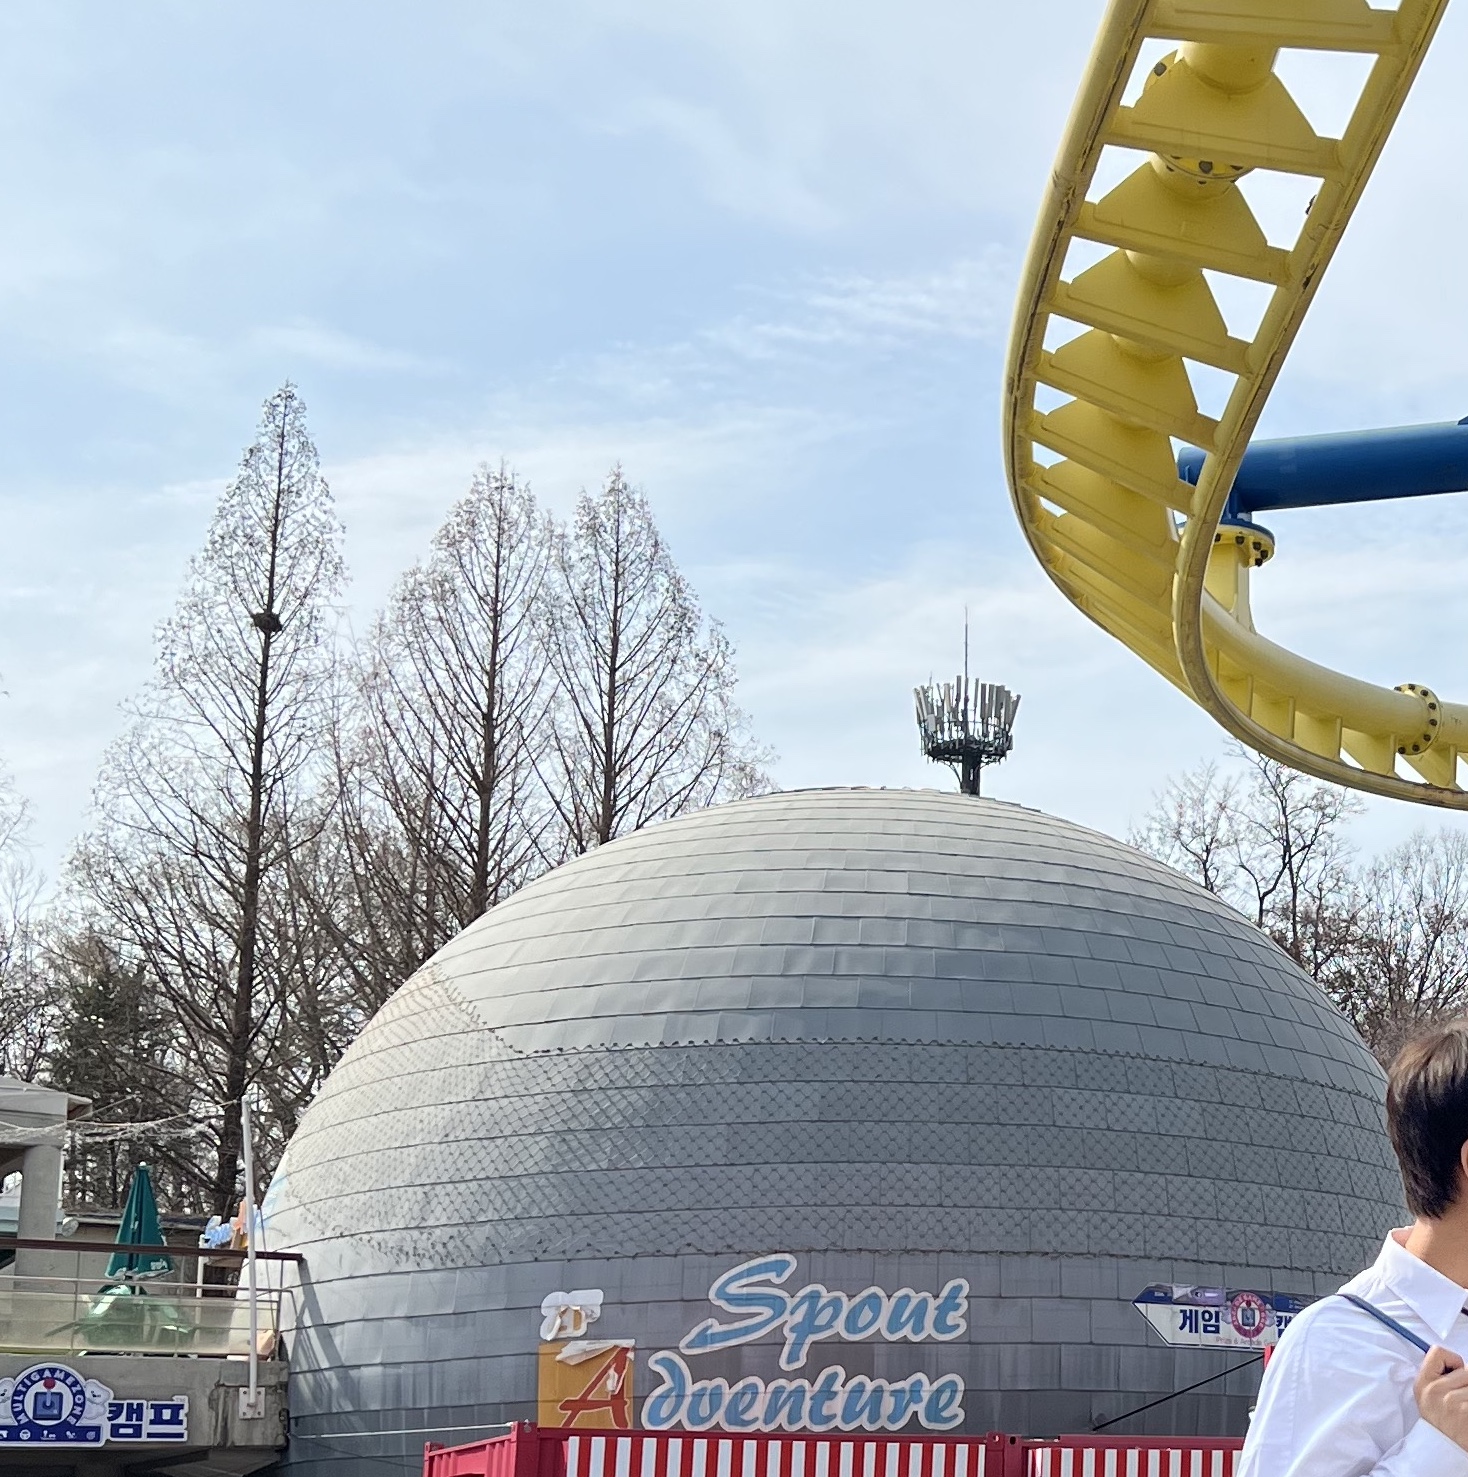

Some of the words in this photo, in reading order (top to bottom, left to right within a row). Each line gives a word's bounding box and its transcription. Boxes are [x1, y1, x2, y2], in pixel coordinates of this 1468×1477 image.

[682, 1256, 968, 1369] Spout
[1179, 1309, 1220, 1334] 게임
[107, 1402, 184, 1438] 캠프
